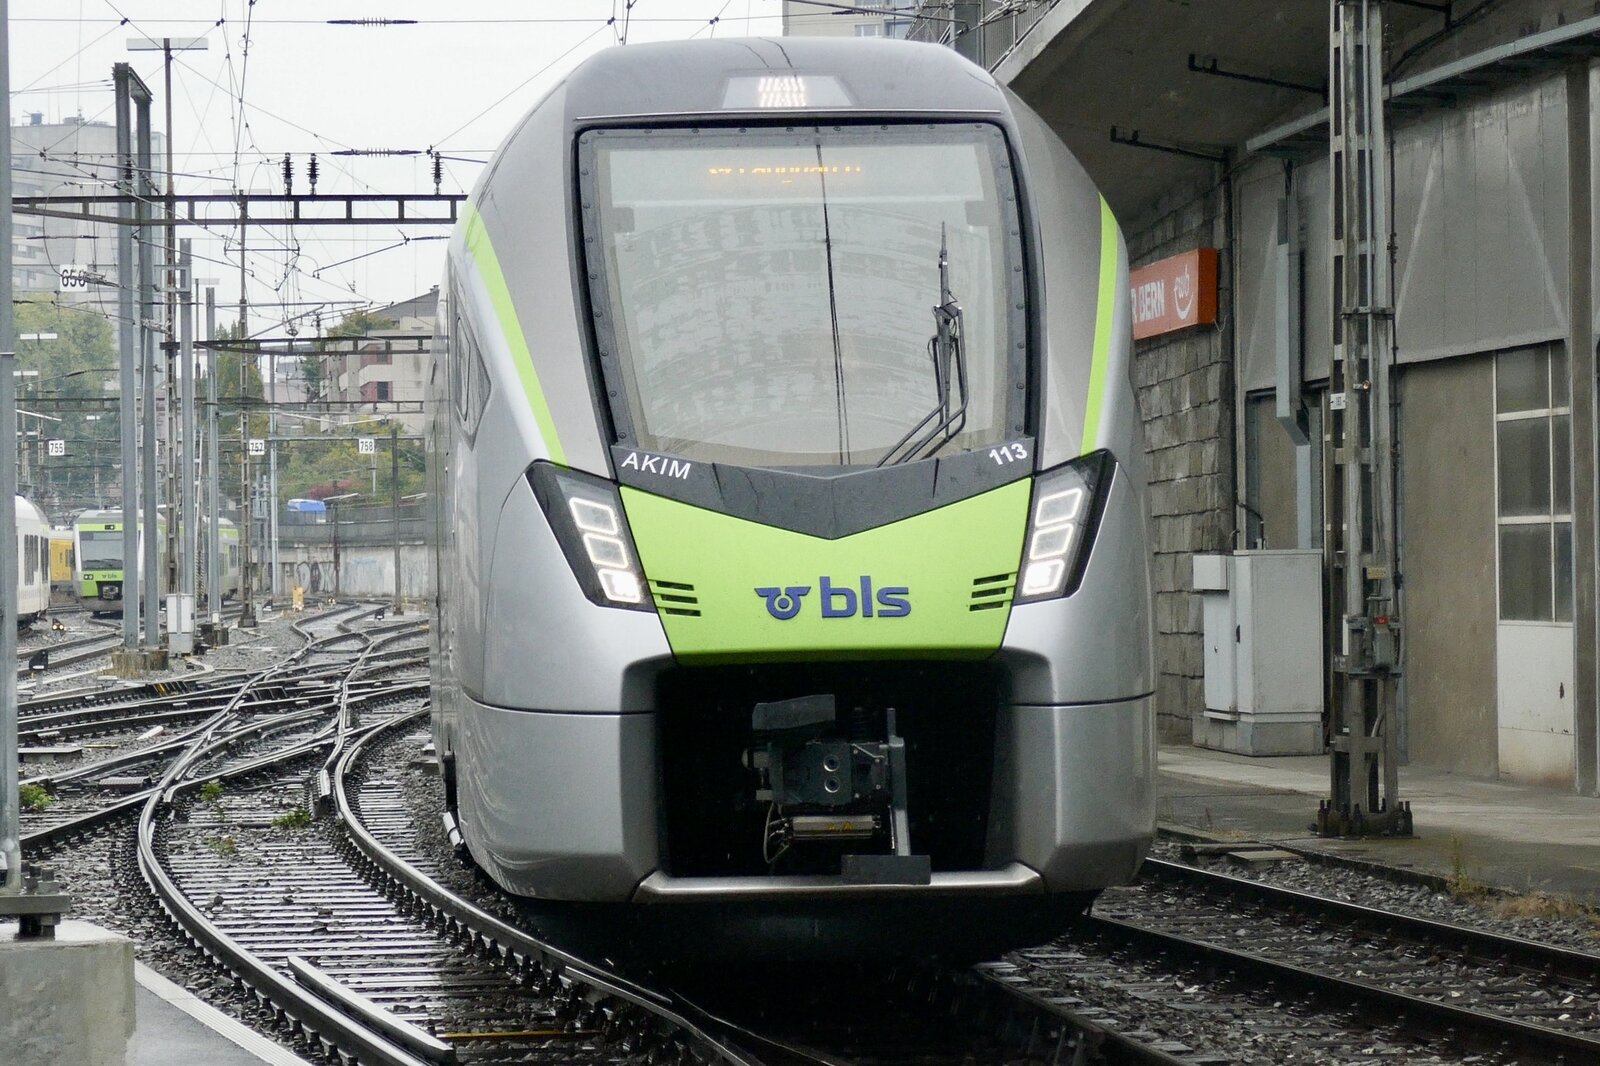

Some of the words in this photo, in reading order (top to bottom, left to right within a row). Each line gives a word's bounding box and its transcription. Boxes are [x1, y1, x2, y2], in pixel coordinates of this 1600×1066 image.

[1138, 279, 1165, 322] BERN
[50, 443, 63, 453] 755
[360, 441, 373, 452] 758
[988, 442, 1028, 466] 113
[621, 452, 691, 480] AKIM
[819, 575, 912, 618] bls
